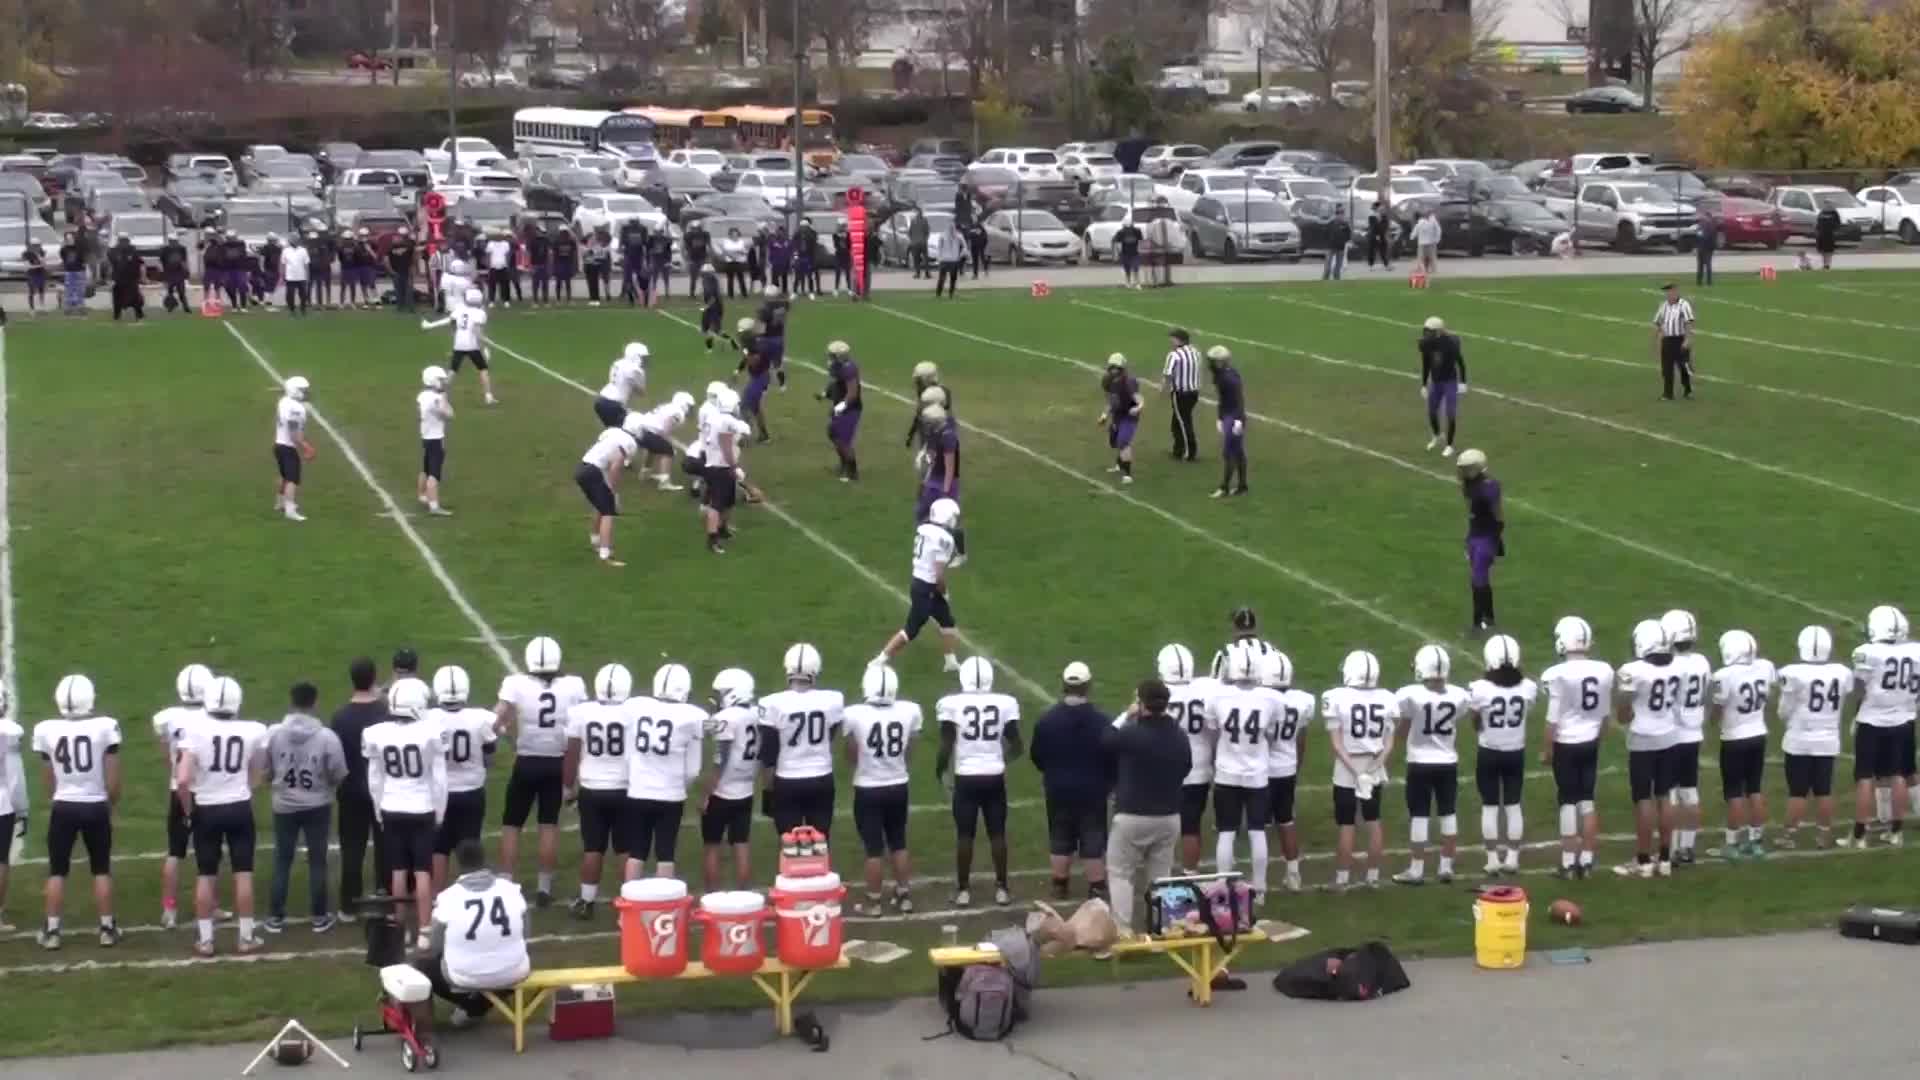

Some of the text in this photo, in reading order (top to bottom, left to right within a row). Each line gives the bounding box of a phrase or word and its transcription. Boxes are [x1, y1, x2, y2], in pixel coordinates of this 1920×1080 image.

[1881, 656, 1913, 690] 20
[538, 692, 556, 728] 2
[1581, 676, 1599, 711] 6
[1648, 676, 1680, 711] 83
[1737, 679, 1767, 714] 36
[1807, 678, 1841, 712] 64
[787, 710, 825, 747] 70
[962, 705, 1000, 741] 32
[1224, 707, 1261, 745] 44
[1350, 703, 1385, 738] 85
[1421, 701, 1457, 736] 12
[1487, 695, 1525, 728] 23
[444, 729, 471, 762] 0
[585, 721, 625, 757] 68
[635, 715, 674, 757] 63
[742, 724, 760, 761] 2
[866, 721, 904, 758] 48
[54, 735, 93, 774] 40
[208, 735, 244, 773] 10
[383, 744, 424, 778] 80
[283, 767, 313, 790] 46
[464, 895, 511, 940] 74
[653, 913, 675, 936] G
[729, 924, 748, 944] G
